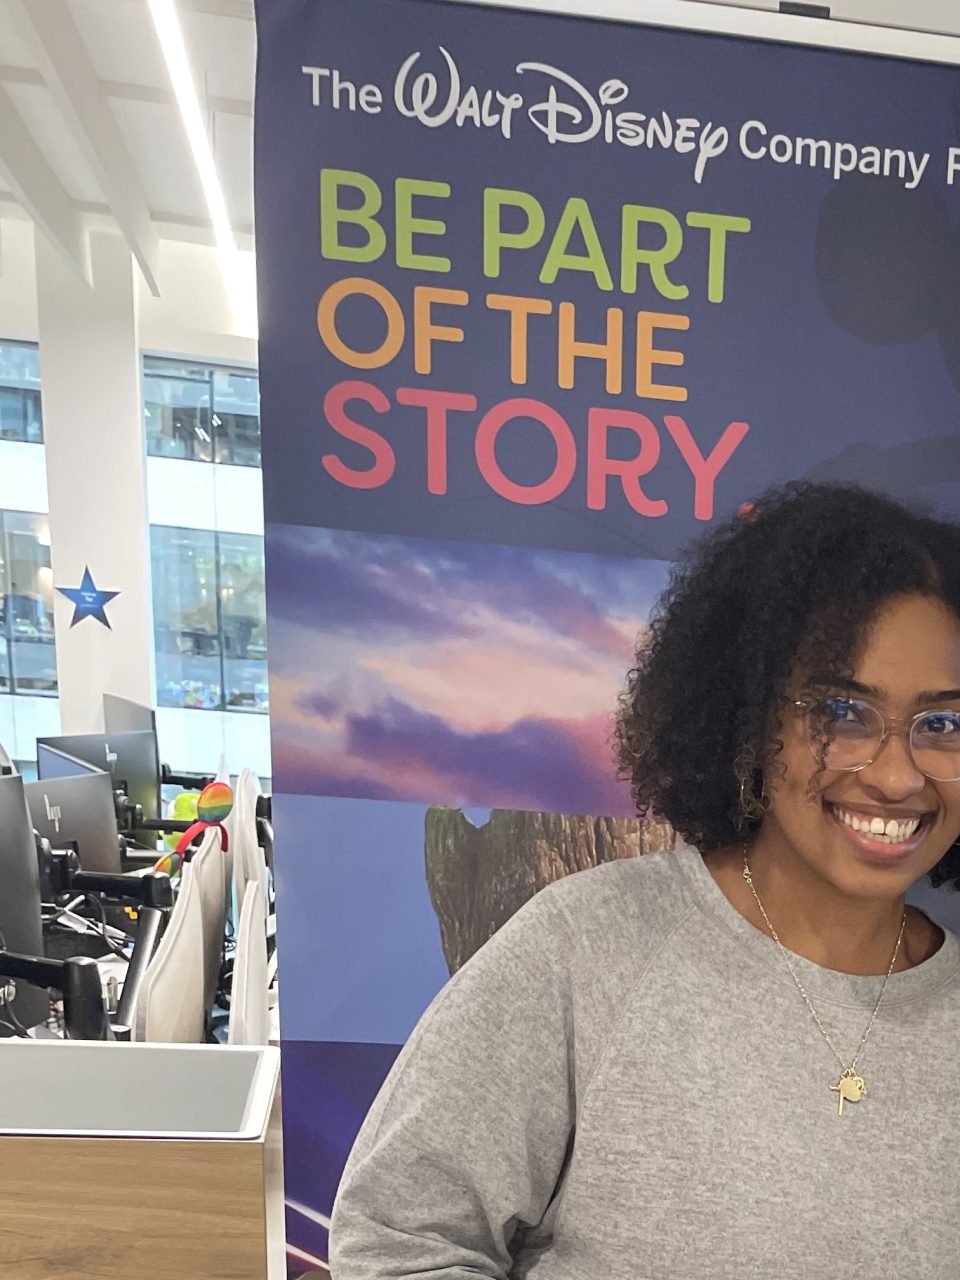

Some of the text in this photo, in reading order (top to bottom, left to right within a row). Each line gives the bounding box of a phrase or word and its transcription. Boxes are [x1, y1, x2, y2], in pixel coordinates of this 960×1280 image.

[302, 65, 383, 113] The
[738, 120, 930, 190] Company
[319, 167, 751, 304] BE PART
[316, 276, 691, 402] OF THE
